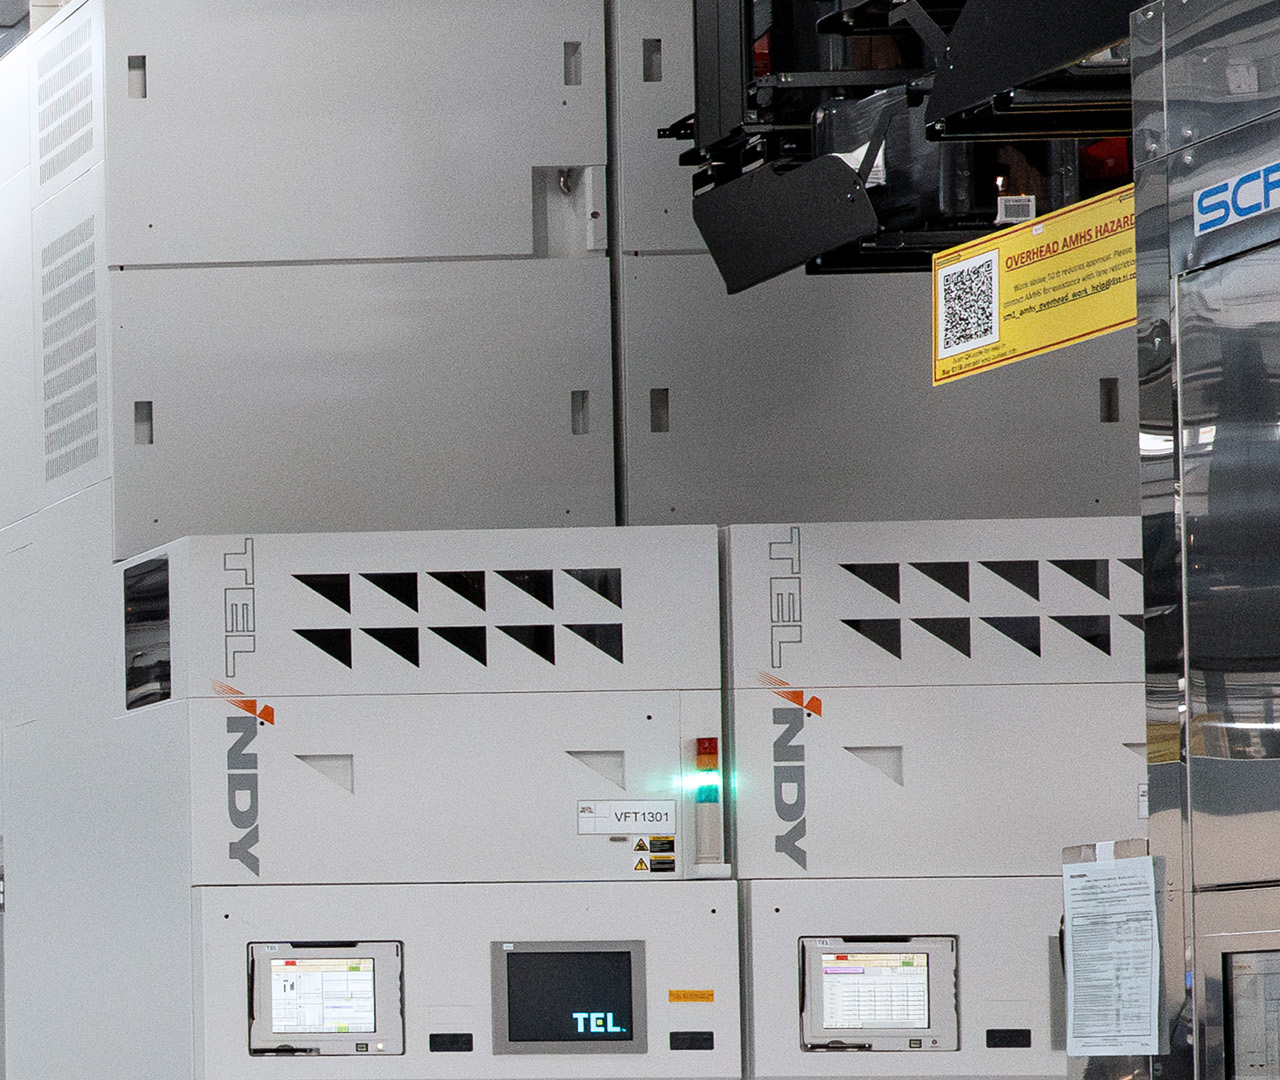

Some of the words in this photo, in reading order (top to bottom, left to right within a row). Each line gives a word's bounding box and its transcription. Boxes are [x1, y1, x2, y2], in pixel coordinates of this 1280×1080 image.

[1005, 241, 1059, 269] OVERHEAD
[1061, 231, 1093, 251] AMHS
[223, 537, 255, 678] TEL
[768, 526, 803, 669] TEL
[614, 811, 669, 822] VFT1301
